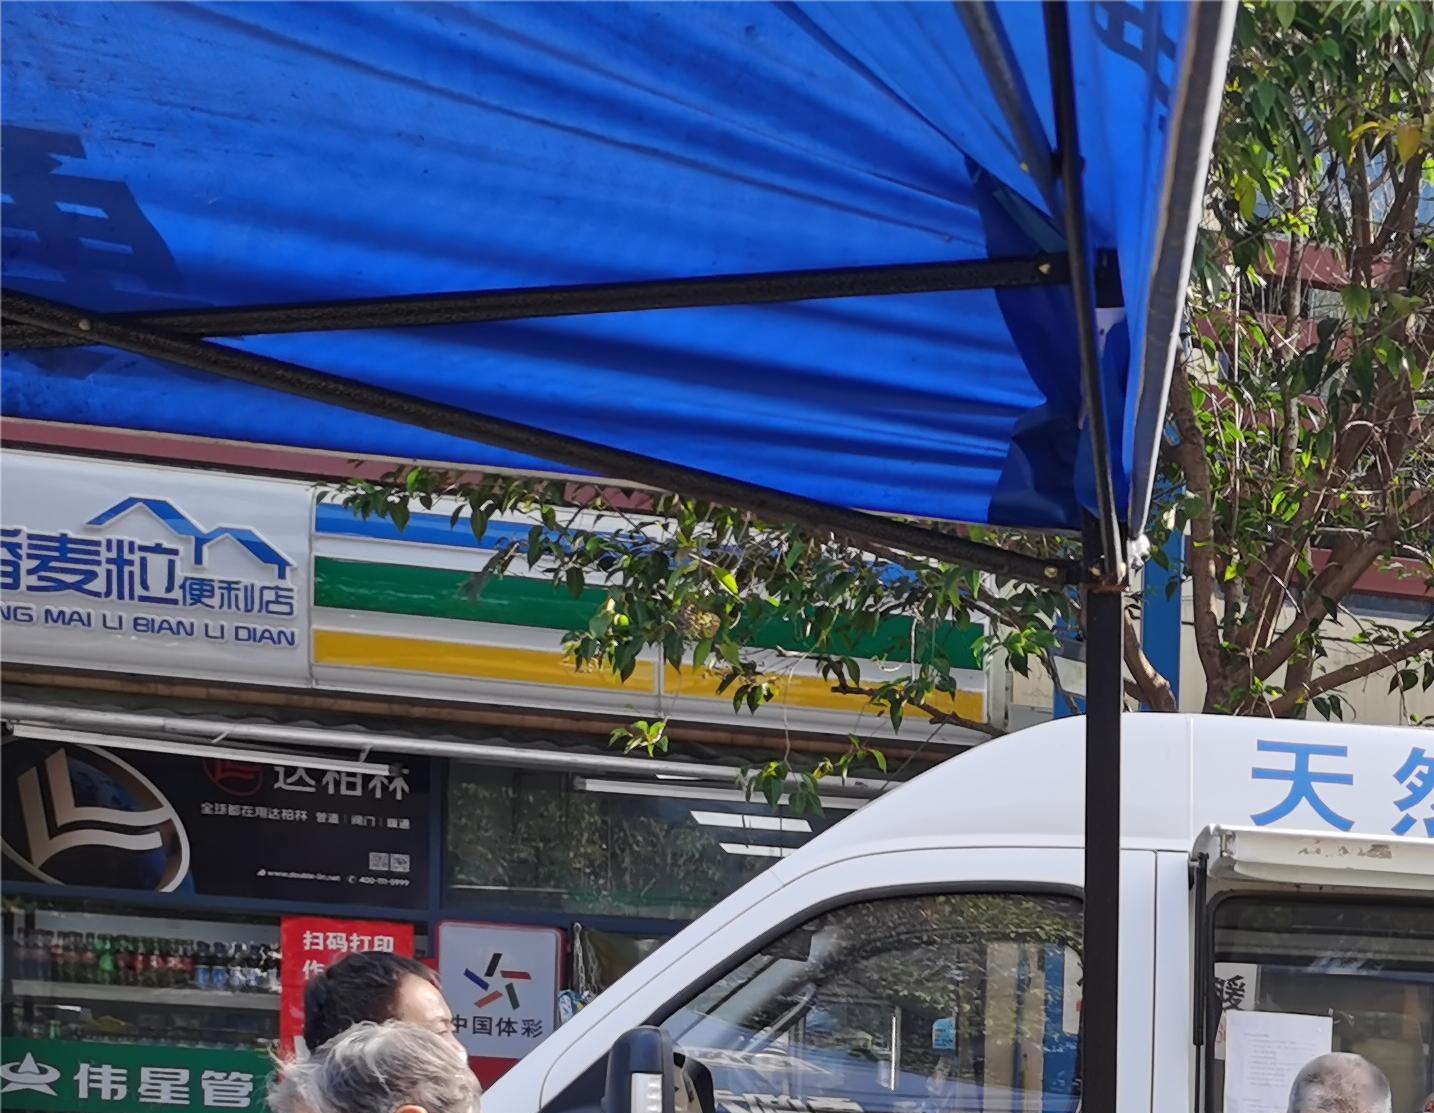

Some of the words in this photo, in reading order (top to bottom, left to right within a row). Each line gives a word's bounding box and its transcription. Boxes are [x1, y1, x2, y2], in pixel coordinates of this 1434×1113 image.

[179, 576, 295, 616] 便利店
[44, 609, 92, 628] MAI
[102, 613, 123, 630] LI
[133, 617, 194, 637] BIAN
[205, 622, 225, 640] LI
[235, 625, 296, 647] DIAN
[303, 930, 394, 952] 扫码打印
[452, 1014, 543, 1038] 中国体彩
[73, 1062, 254, 1108] 伟星管
